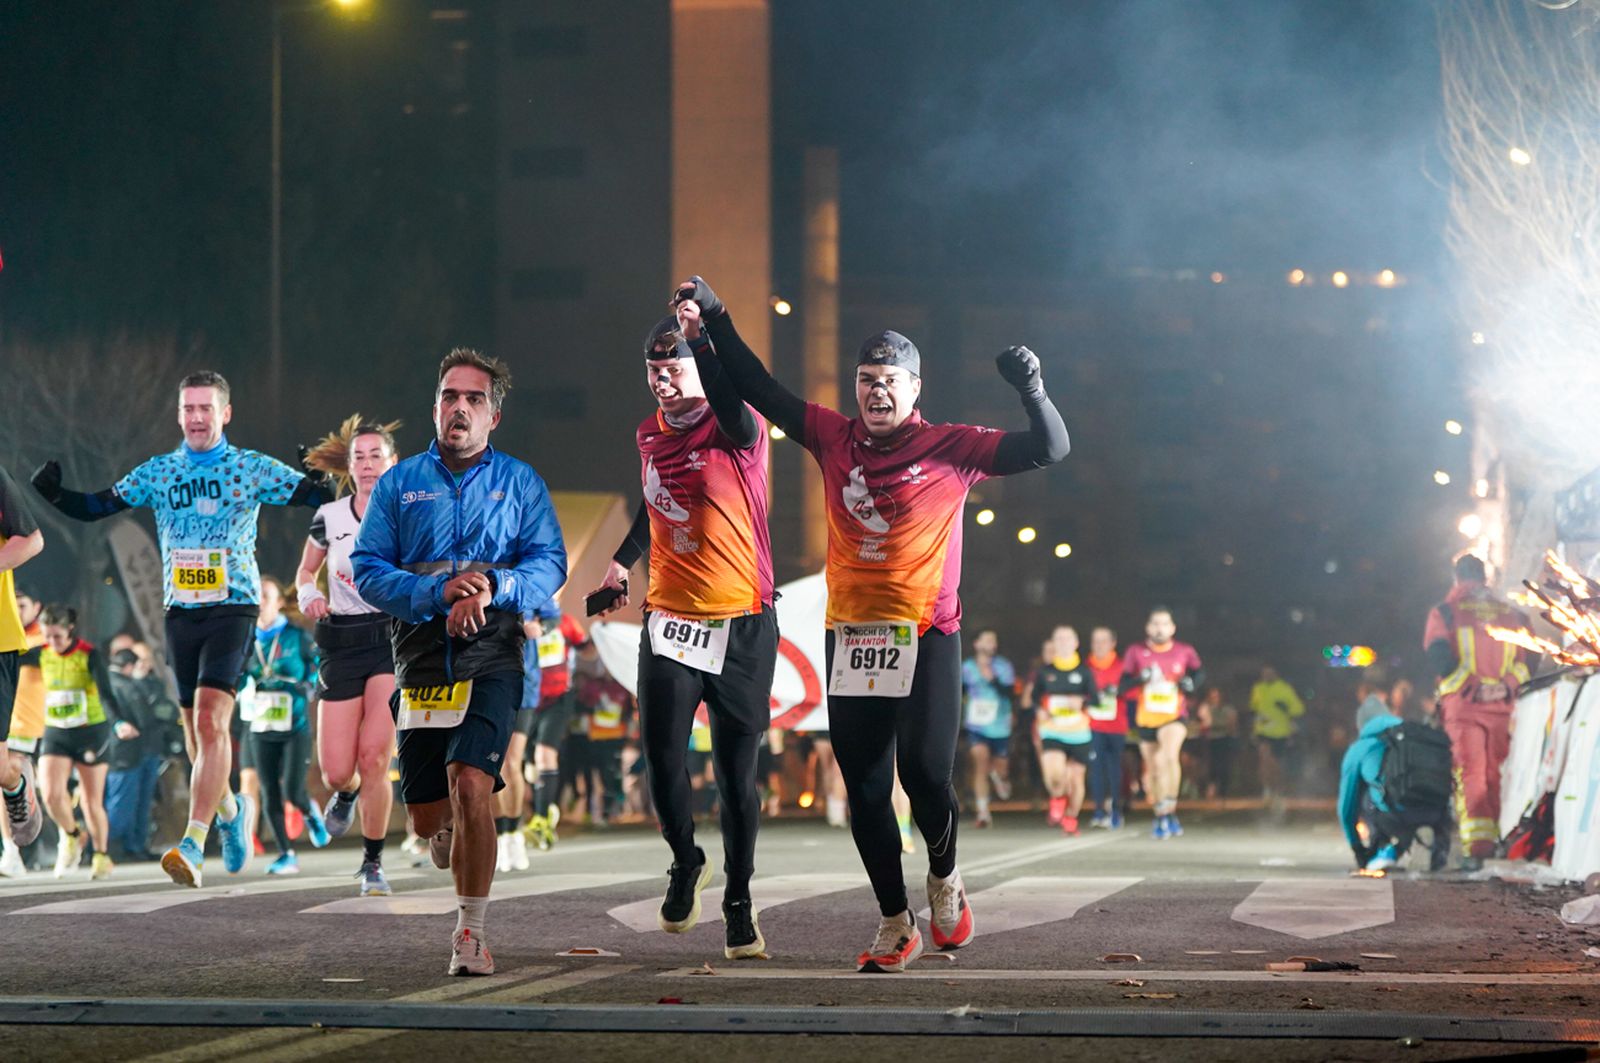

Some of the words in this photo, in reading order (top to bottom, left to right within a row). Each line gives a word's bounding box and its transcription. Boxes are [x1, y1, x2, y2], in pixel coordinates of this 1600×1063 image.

[168, 476, 221, 510] COMO
[655, 493, 672, 512] 43
[852, 500, 873, 520] 43
[178, 568, 216, 585] 8568
[663, 620, 711, 649] 6911
[850, 647, 900, 670] 6912
[408, 684, 453, 702] 4021
